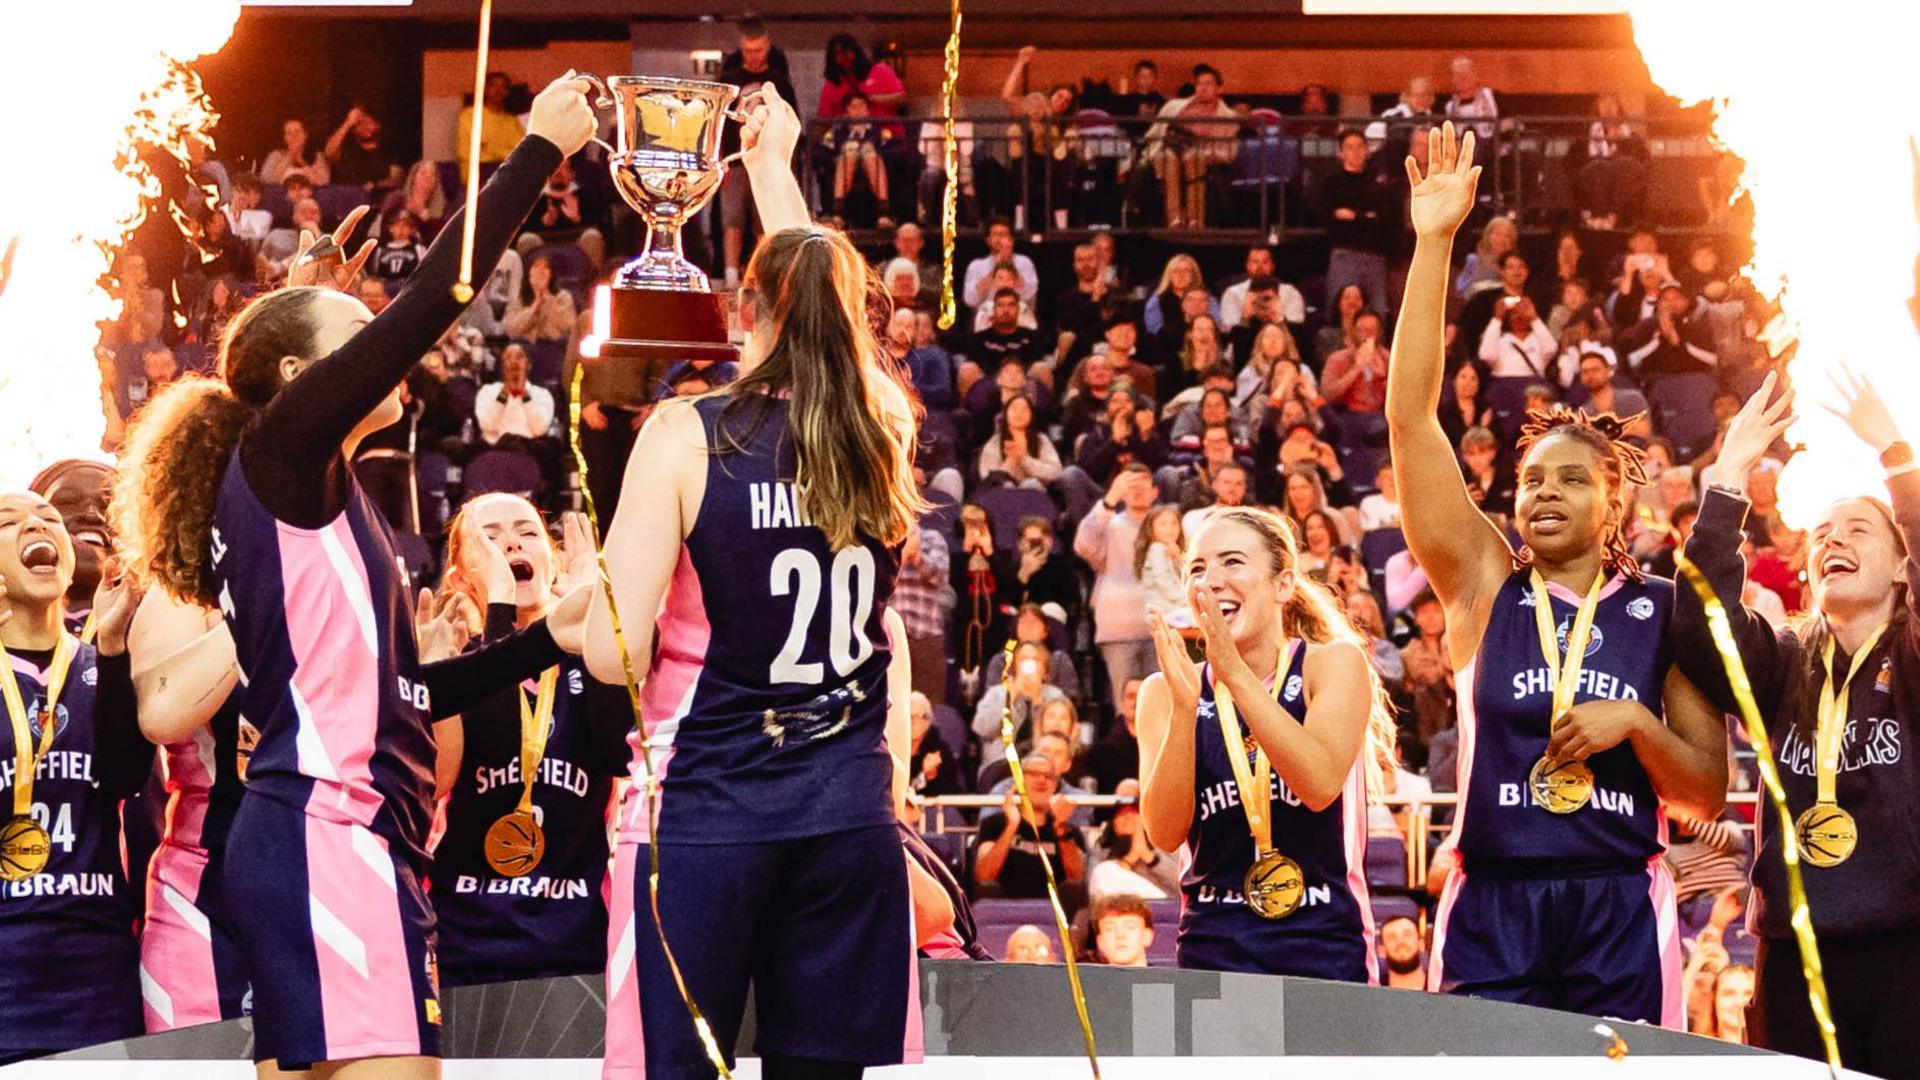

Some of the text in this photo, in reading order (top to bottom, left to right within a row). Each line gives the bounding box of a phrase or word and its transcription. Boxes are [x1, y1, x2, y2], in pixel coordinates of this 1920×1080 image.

[769, 545, 876, 684] 20
[1513, 667, 1638, 702] SHFIELD
[0, 750, 99, 792] HFFIEL
[475, 756, 588, 798] SHEIELD
[31, 801, 76, 852] 24
